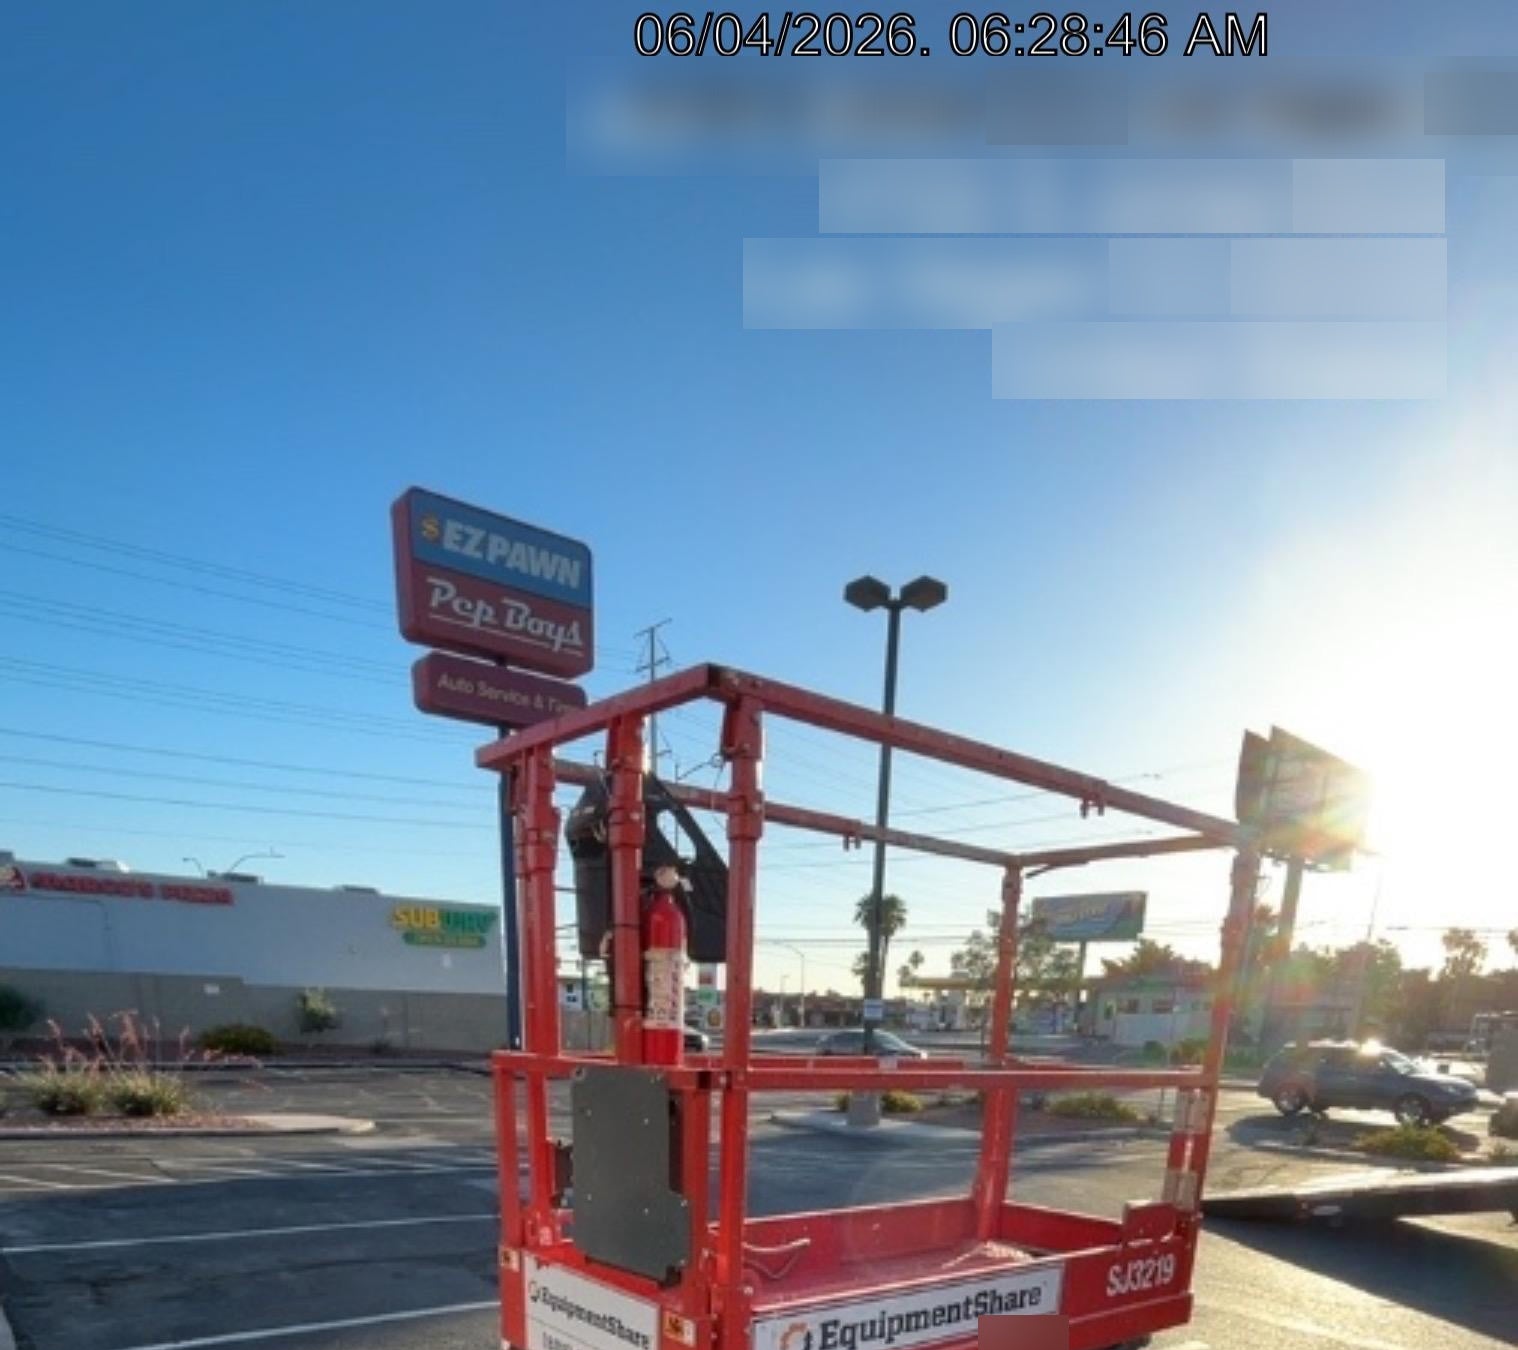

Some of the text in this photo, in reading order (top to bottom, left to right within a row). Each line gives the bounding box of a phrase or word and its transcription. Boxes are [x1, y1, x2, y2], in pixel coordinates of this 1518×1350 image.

[427, 576, 583, 652] Pep Boys
[437, 673, 475, 694] Auto
[476, 680, 530, 707] Service
[1106, 1253, 1175, 1297] SJ3219
